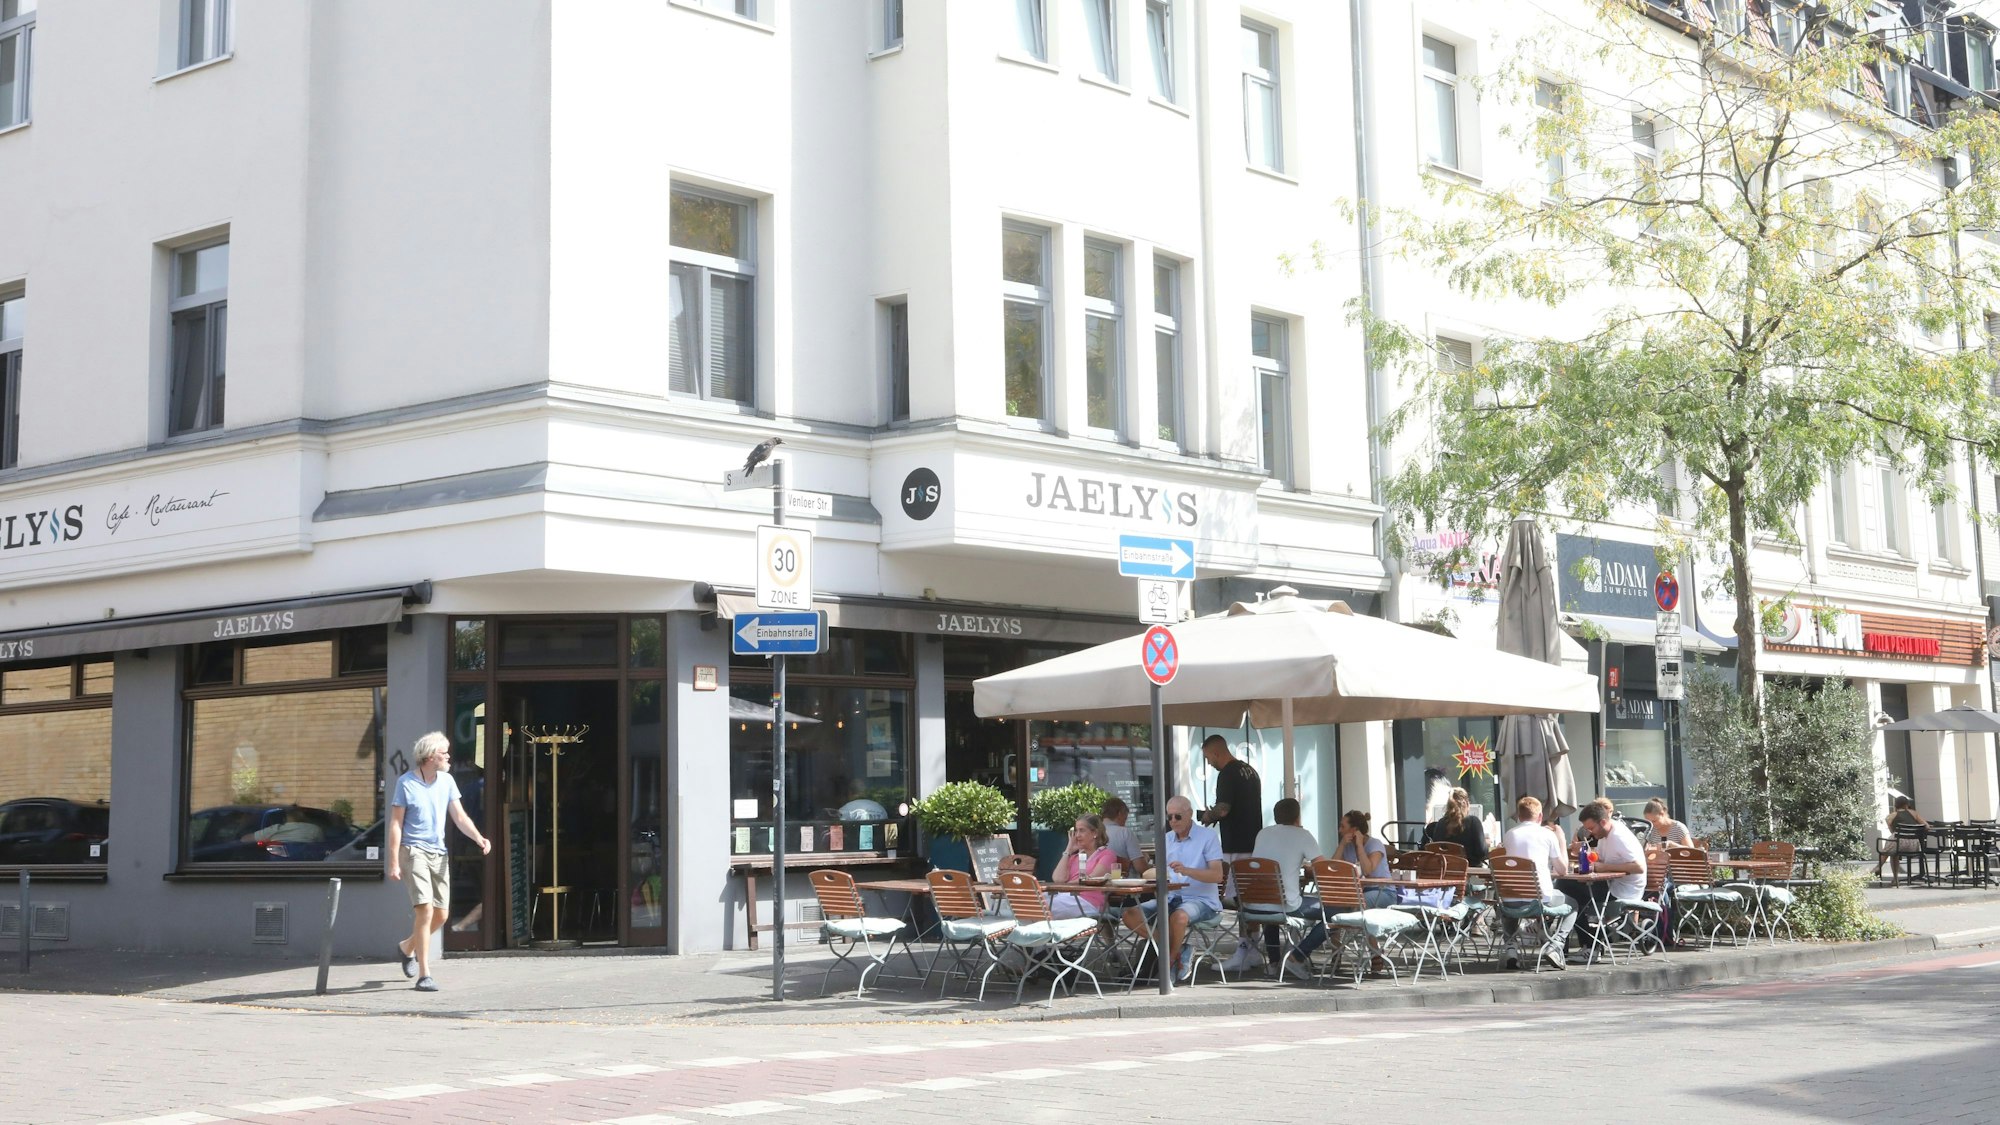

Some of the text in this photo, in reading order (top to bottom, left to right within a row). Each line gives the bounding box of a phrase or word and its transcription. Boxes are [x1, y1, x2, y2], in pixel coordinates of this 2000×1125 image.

[144, 489, 229, 527] Restaurant
[787, 493, 830, 511] Venloer Str.
[774, 547, 795, 573] 30
[1123, 549, 1174, 564] Einbahnstraße
[1604, 561, 1648, 589] ADAM
[771, 590, 798, 605] ZONE
[1604, 585, 1648, 598] JUWELIER
[756, 627, 813, 638] Einbahnstraße
[1628, 699, 1653, 715] ADAM
